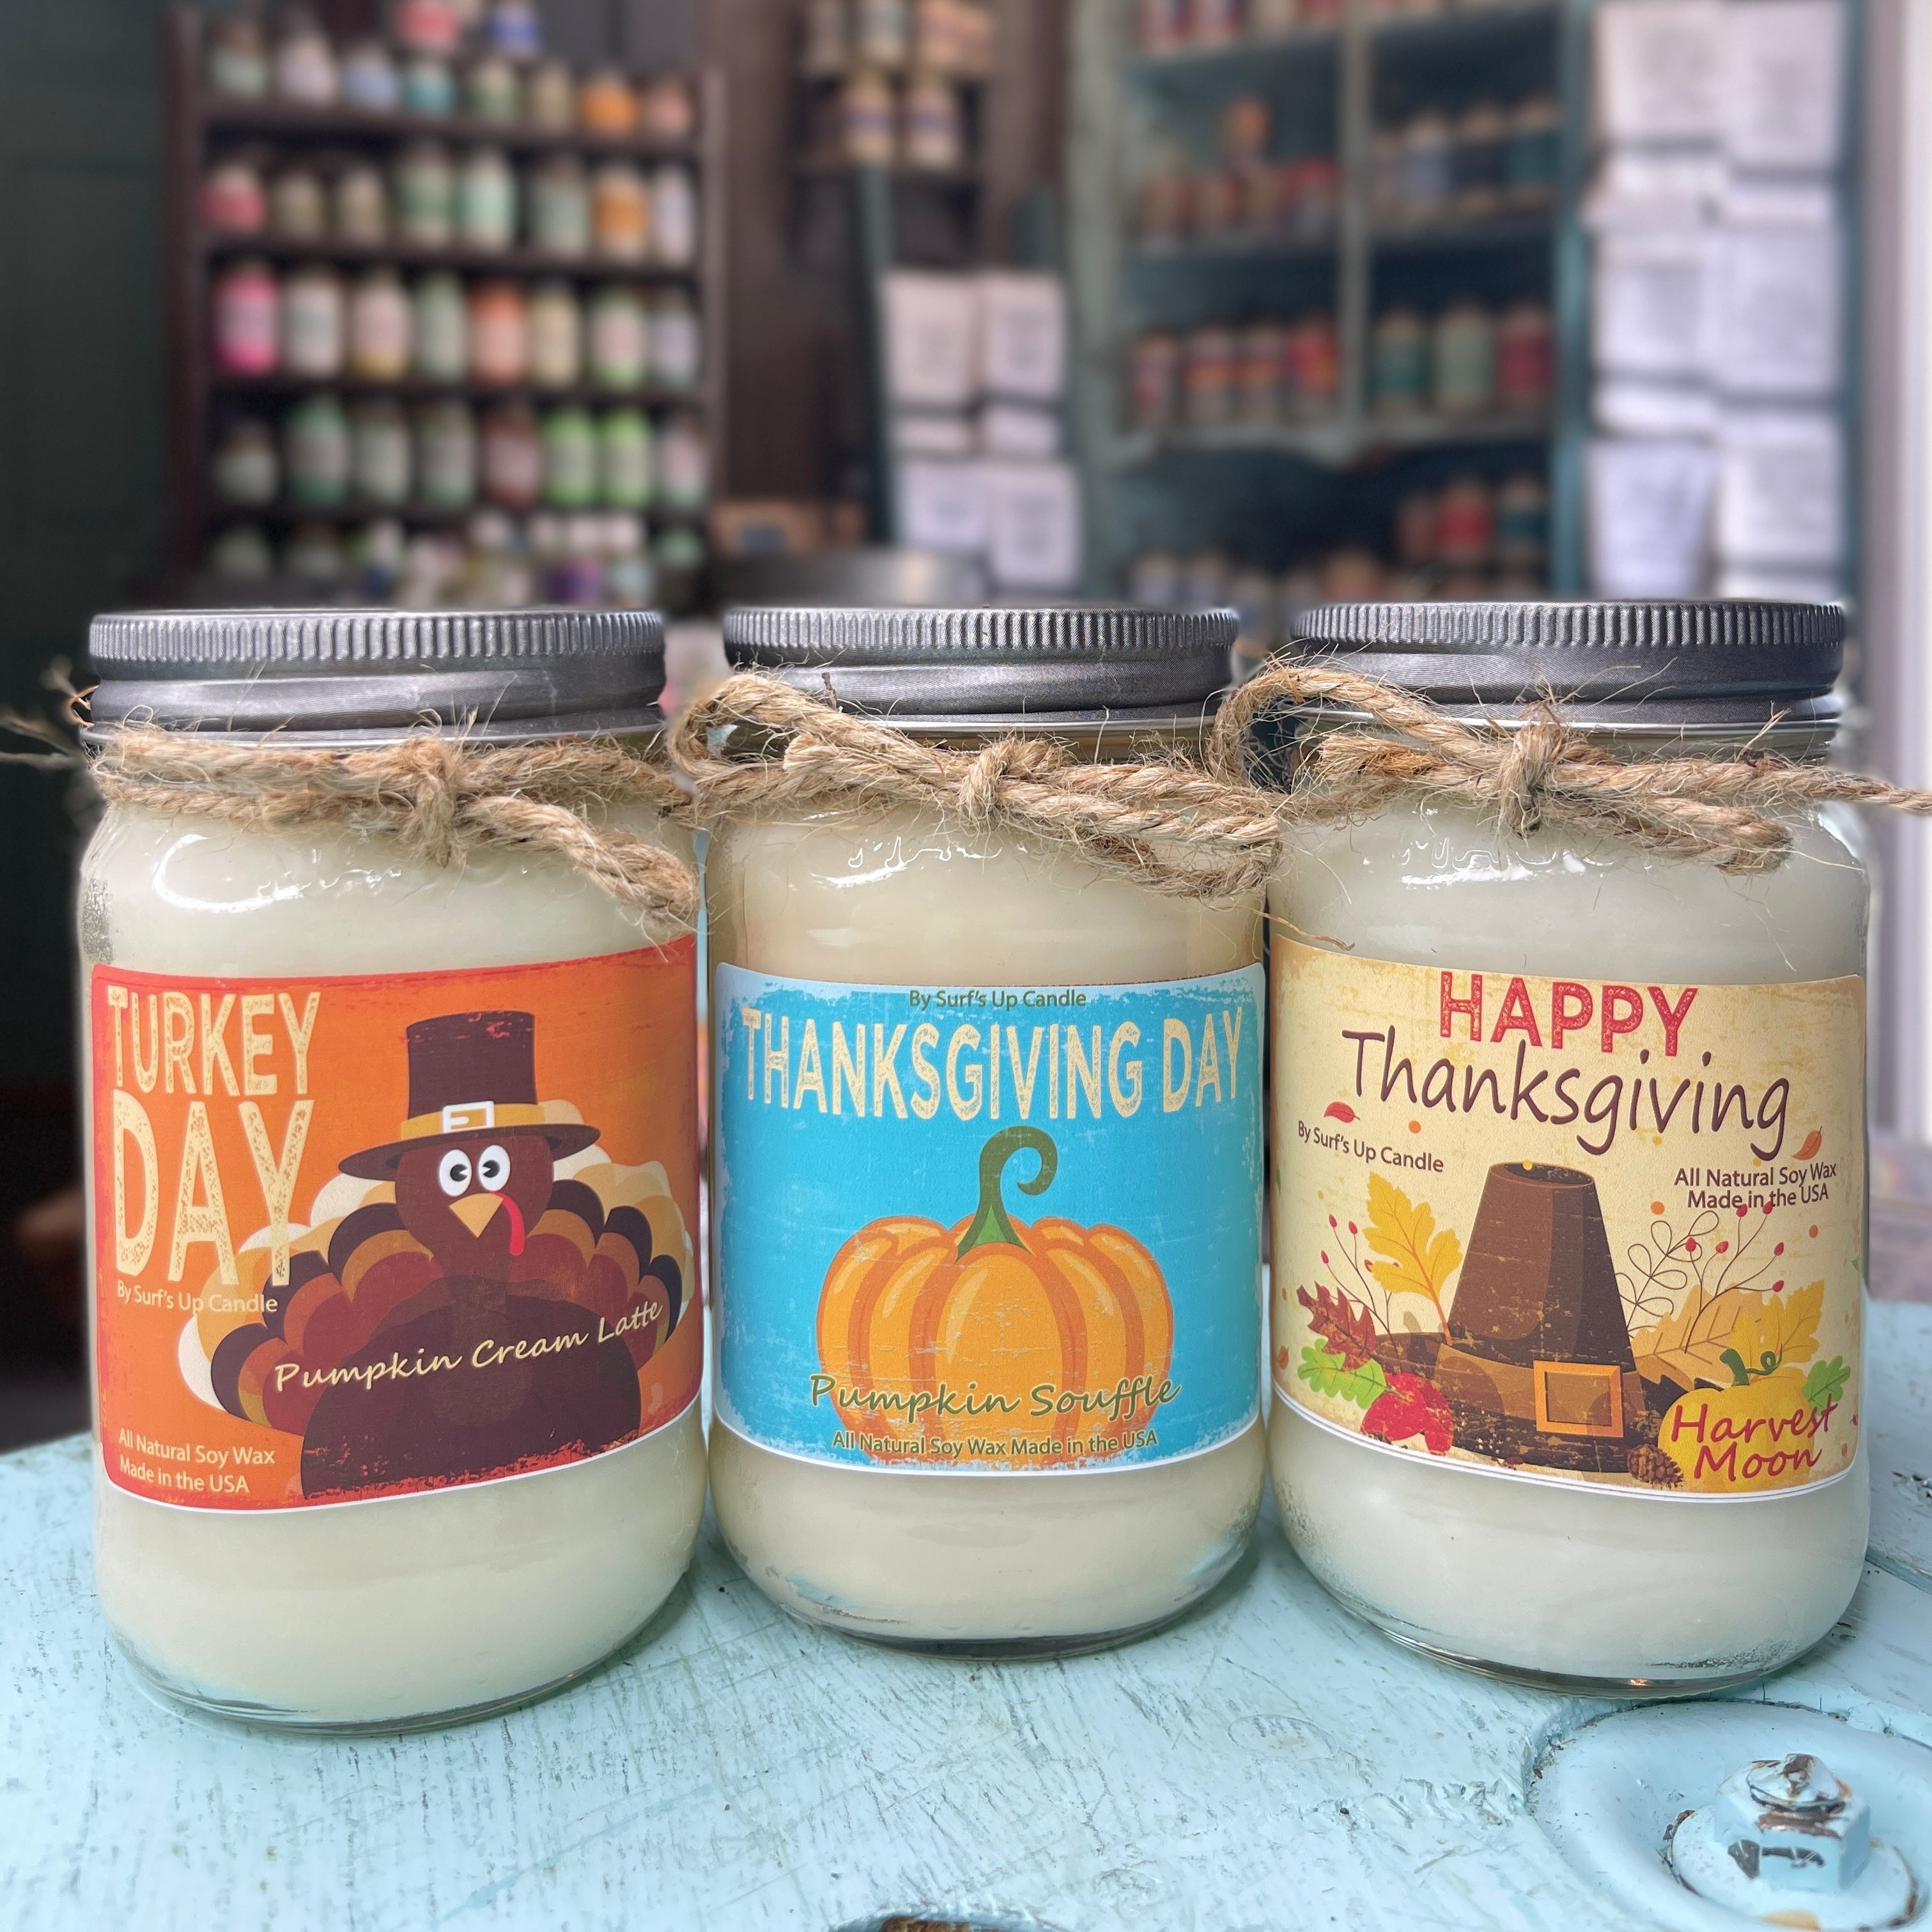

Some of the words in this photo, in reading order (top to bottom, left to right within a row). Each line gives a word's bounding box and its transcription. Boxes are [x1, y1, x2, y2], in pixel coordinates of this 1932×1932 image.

[909, 990, 931, 1010] By
[936, 990, 987, 1007] Surf's
[992, 991, 1017, 1011] Up
[1023, 989, 1086, 1007] Candle
[1441, 971, 1698, 1056] HAPPY
[108, 985, 320, 1096] TURKEY
[742, 1008, 1143, 1121] THANKSGIVING
[1163, 1006, 1242, 1113] DAY
[1342, 1024, 1789, 1161] Thanksgiving
[1298, 1120, 1311, 1143] By
[1313, 1127, 1349, 1154] Surf's
[1354, 1139, 1377, 1163] Up
[1380, 1146, 1444, 1173] Candle
[113, 1088, 314, 1286] DAY
[1674, 1167, 1699, 1186] All
[1706, 1167, 1774, 1187] Natural
[1779, 1166, 1807, 1187] Soy
[1810, 1162, 1837, 1181] Wax
[1687, 1190, 1742, 1209] Made
[1748, 1191, 1767, 1207] in
[1770, 1188, 1797, 1207] the
[1800, 1183, 1829, 1204] USA
[118, 1280, 131, 1304] By
[134, 1285, 174, 1309] Surf's
[178, 1292, 204, 1315] Up
[208, 1294, 279, 1312] Candle
[275, 1348, 462, 1391] Pumpkin
[472, 1331, 589, 1368] Cream
[598, 1300, 663, 1344] Latte
[810, 1373, 1021, 1423] Pumpkin
[1029, 1375, 1183, 1421] Souffle
[1671, 1393, 1838, 1443] Harvest
[119, 1427, 134, 1448] All
[136, 1434, 190, 1462] Natural
[195, 1445, 229, 1469] Soy
[232, 1446, 276, 1465] Wax
[833, 1430, 854, 1449] All
[860, 1434, 925, 1455] Natural
[930, 1437, 963, 1459] Soy
[966, 1438, 1006, 1456] Wax
[1011, 1436, 1062, 1455] Made
[1067, 1435, 1083, 1453] in
[1088, 1432, 1118, 1452] the
[1123, 1428, 1159, 1449] USA
[1694, 1441, 1822, 1482] Moon
[120, 1454, 155, 1482] Made
[158, 1468, 172, 1487] in
[175, 1471, 205, 1491] the
[210, 1474, 250, 1494] USA
